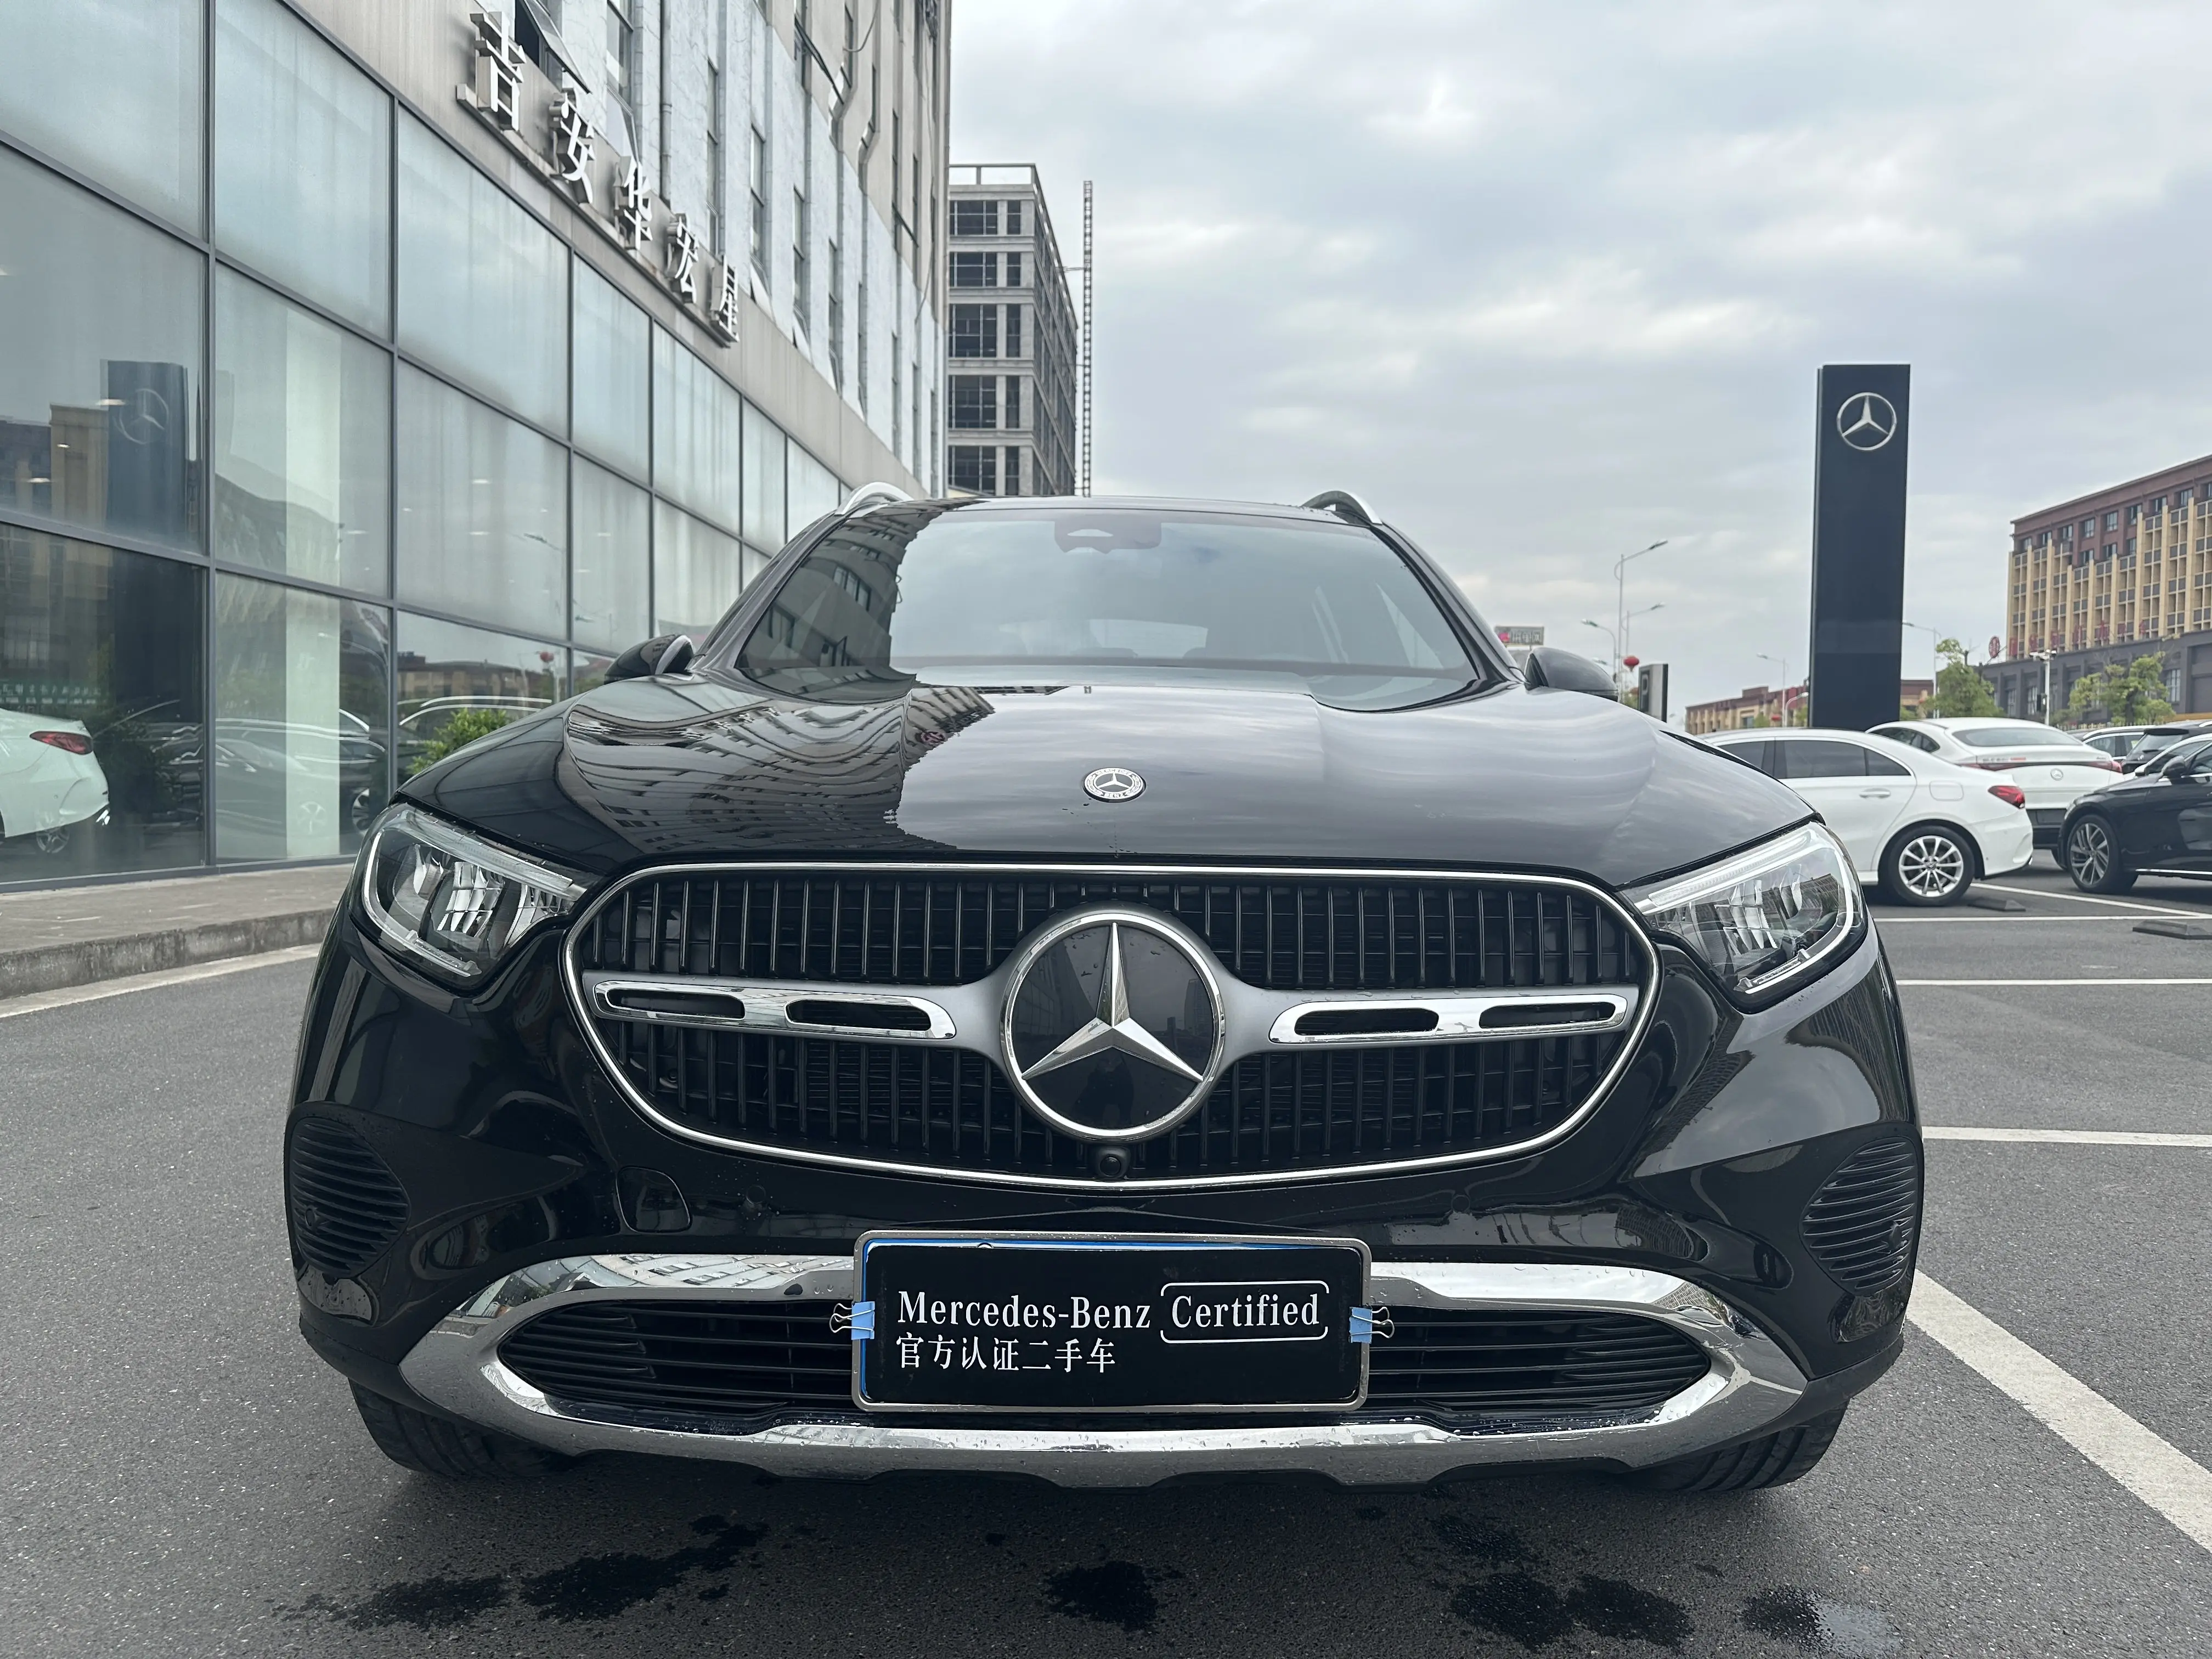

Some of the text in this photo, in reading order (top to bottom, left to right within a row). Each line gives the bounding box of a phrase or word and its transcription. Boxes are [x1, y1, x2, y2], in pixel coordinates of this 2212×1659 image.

[898, 1291, 1319, 1329] Mercedes-Benz Certified
[896, 1331, 1115, 1373] 官方认证二手车
